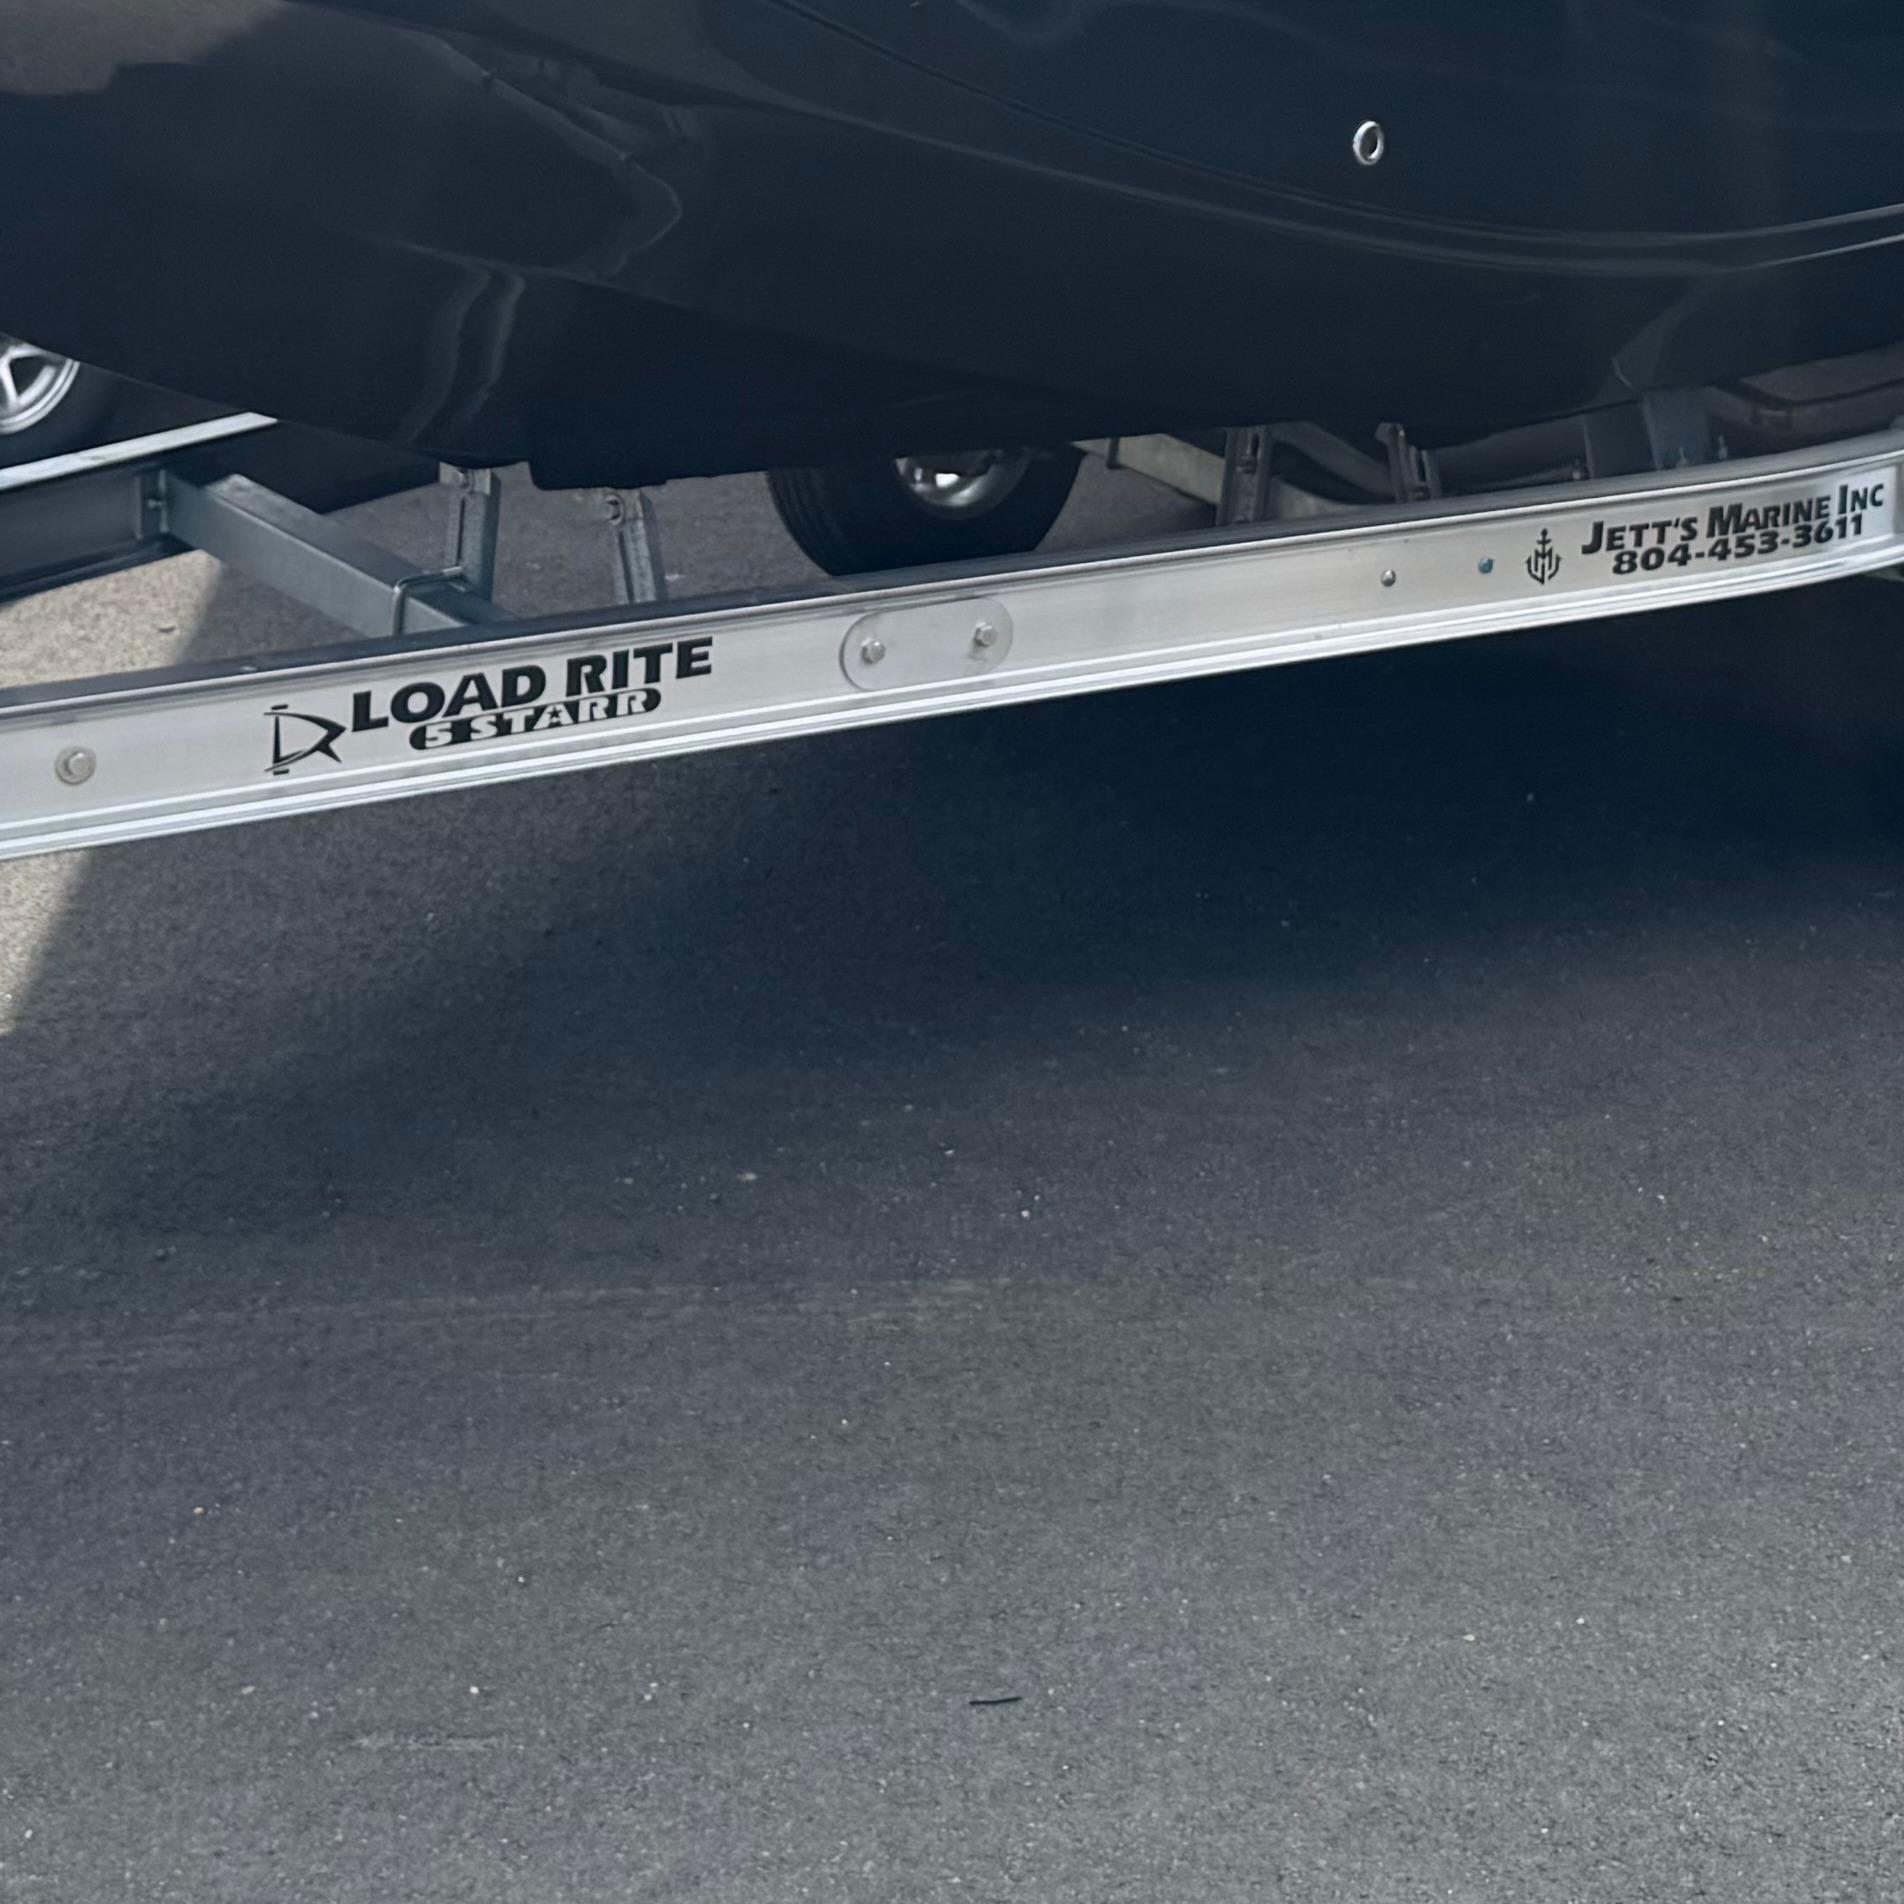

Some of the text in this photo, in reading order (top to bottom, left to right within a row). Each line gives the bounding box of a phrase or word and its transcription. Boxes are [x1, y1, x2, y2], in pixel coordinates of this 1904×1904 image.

[1581, 483, 1885, 555] JETT'S MARINE INC
[1612, 514, 1863, 575] 804-453-3611
[351, 636, 714, 733] LOAD RITE
[424, 688, 649, 749] 5 STARR
